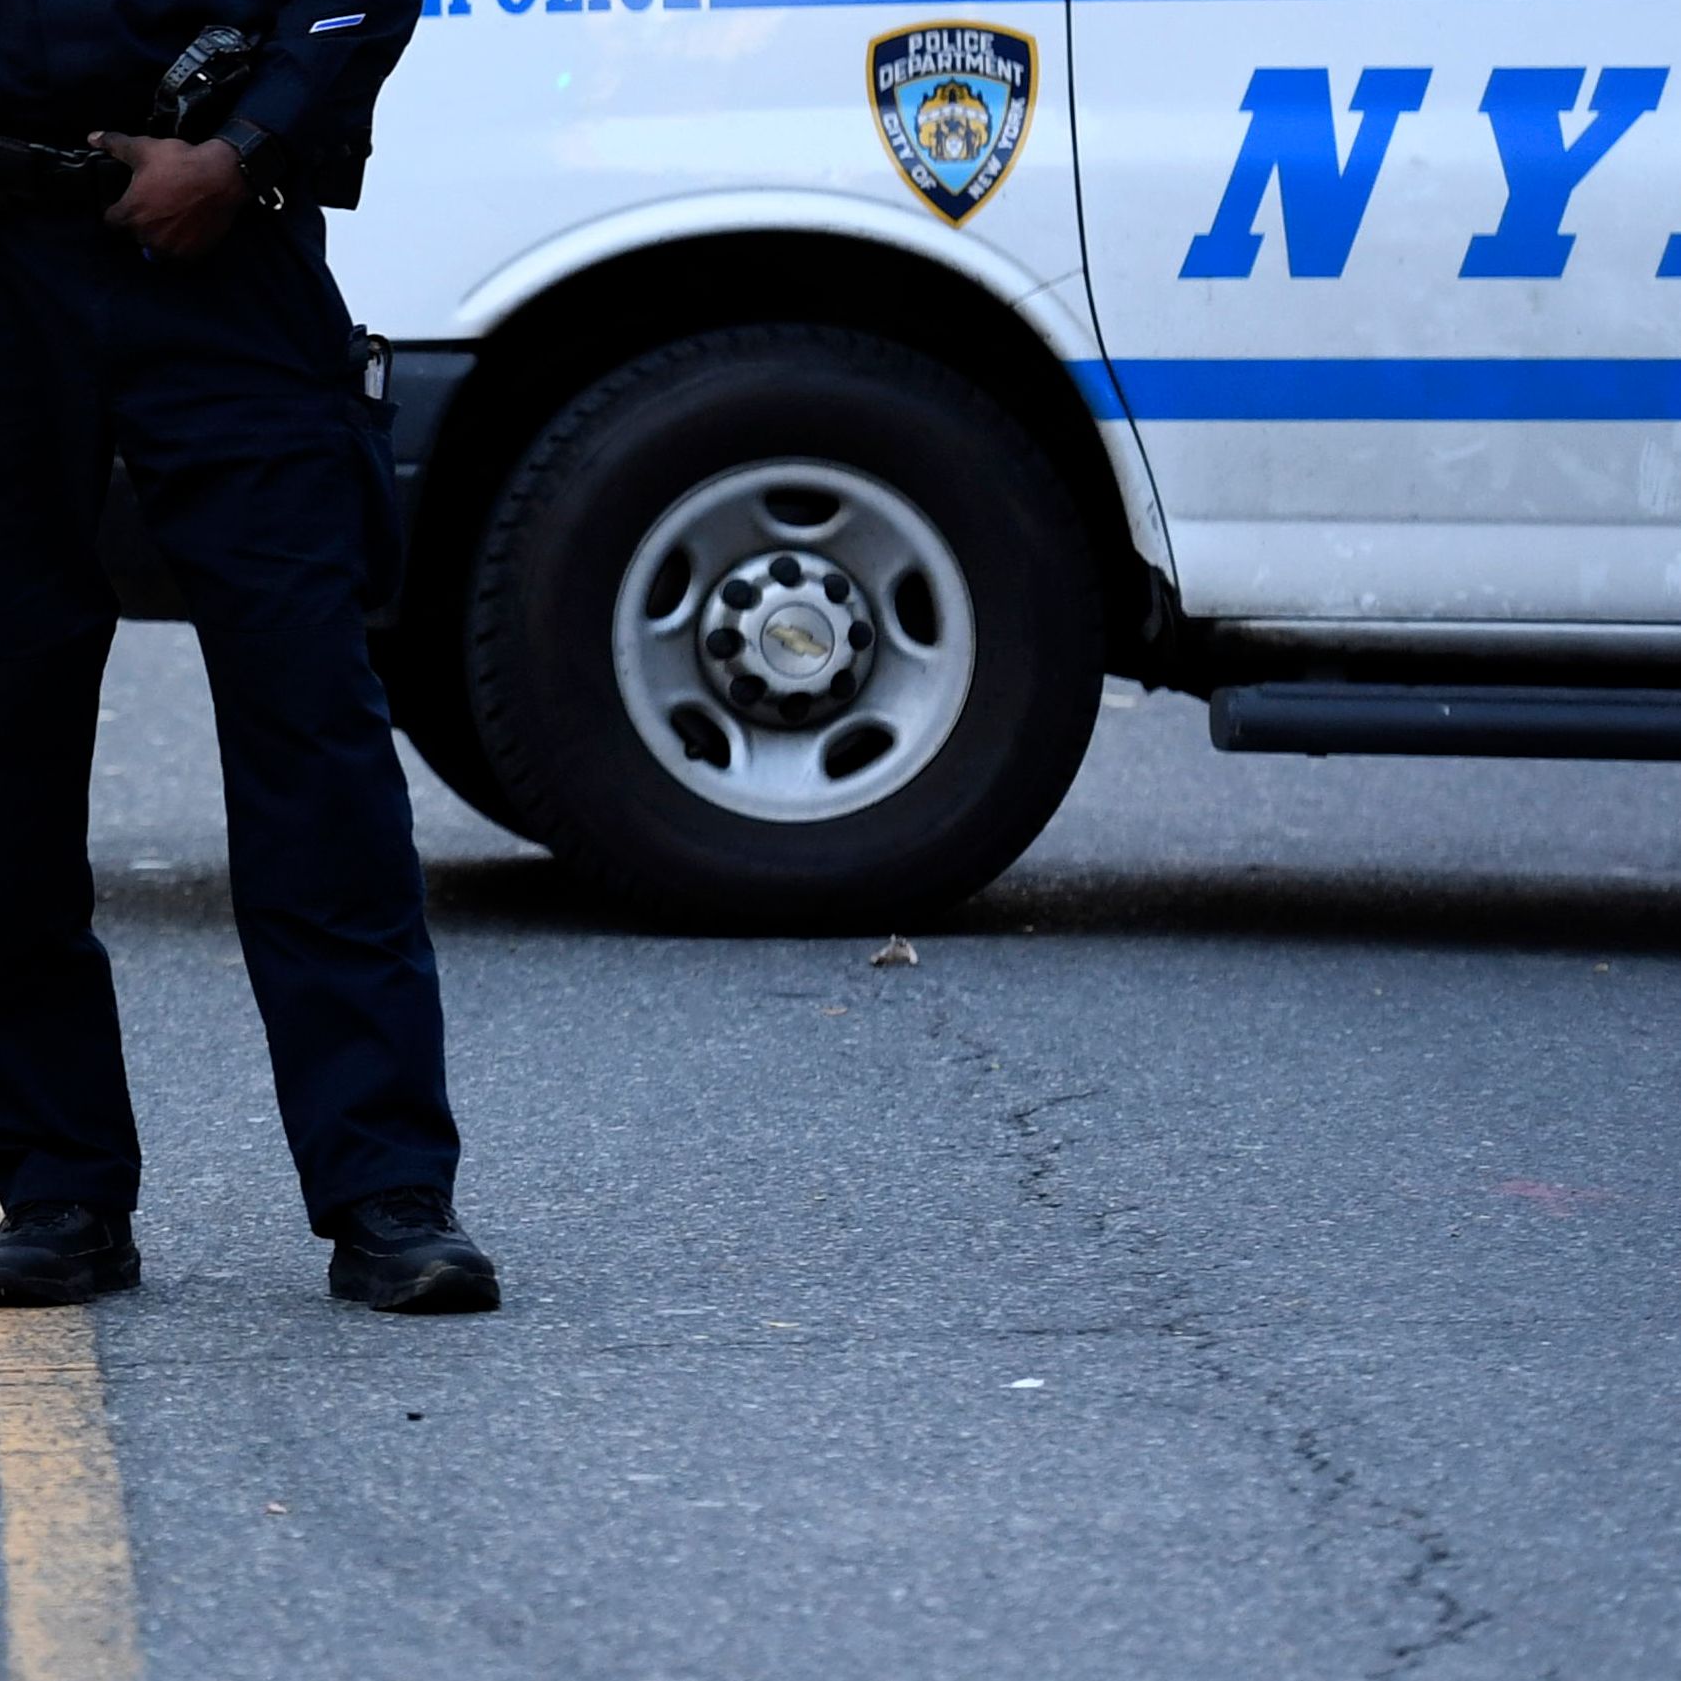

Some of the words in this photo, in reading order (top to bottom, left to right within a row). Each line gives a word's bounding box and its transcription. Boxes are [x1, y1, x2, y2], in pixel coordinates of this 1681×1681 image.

[879, 50, 1025, 93] DEPARTMENT
[908, 29, 995, 55] POLICE
[882, 110, 916, 160] CITY
[910, 163, 938, 191] OF
[967, 154, 1003, 201] NEW
[997, 96, 1027, 150] YORK
[1177, 66, 1681, 278] NY
